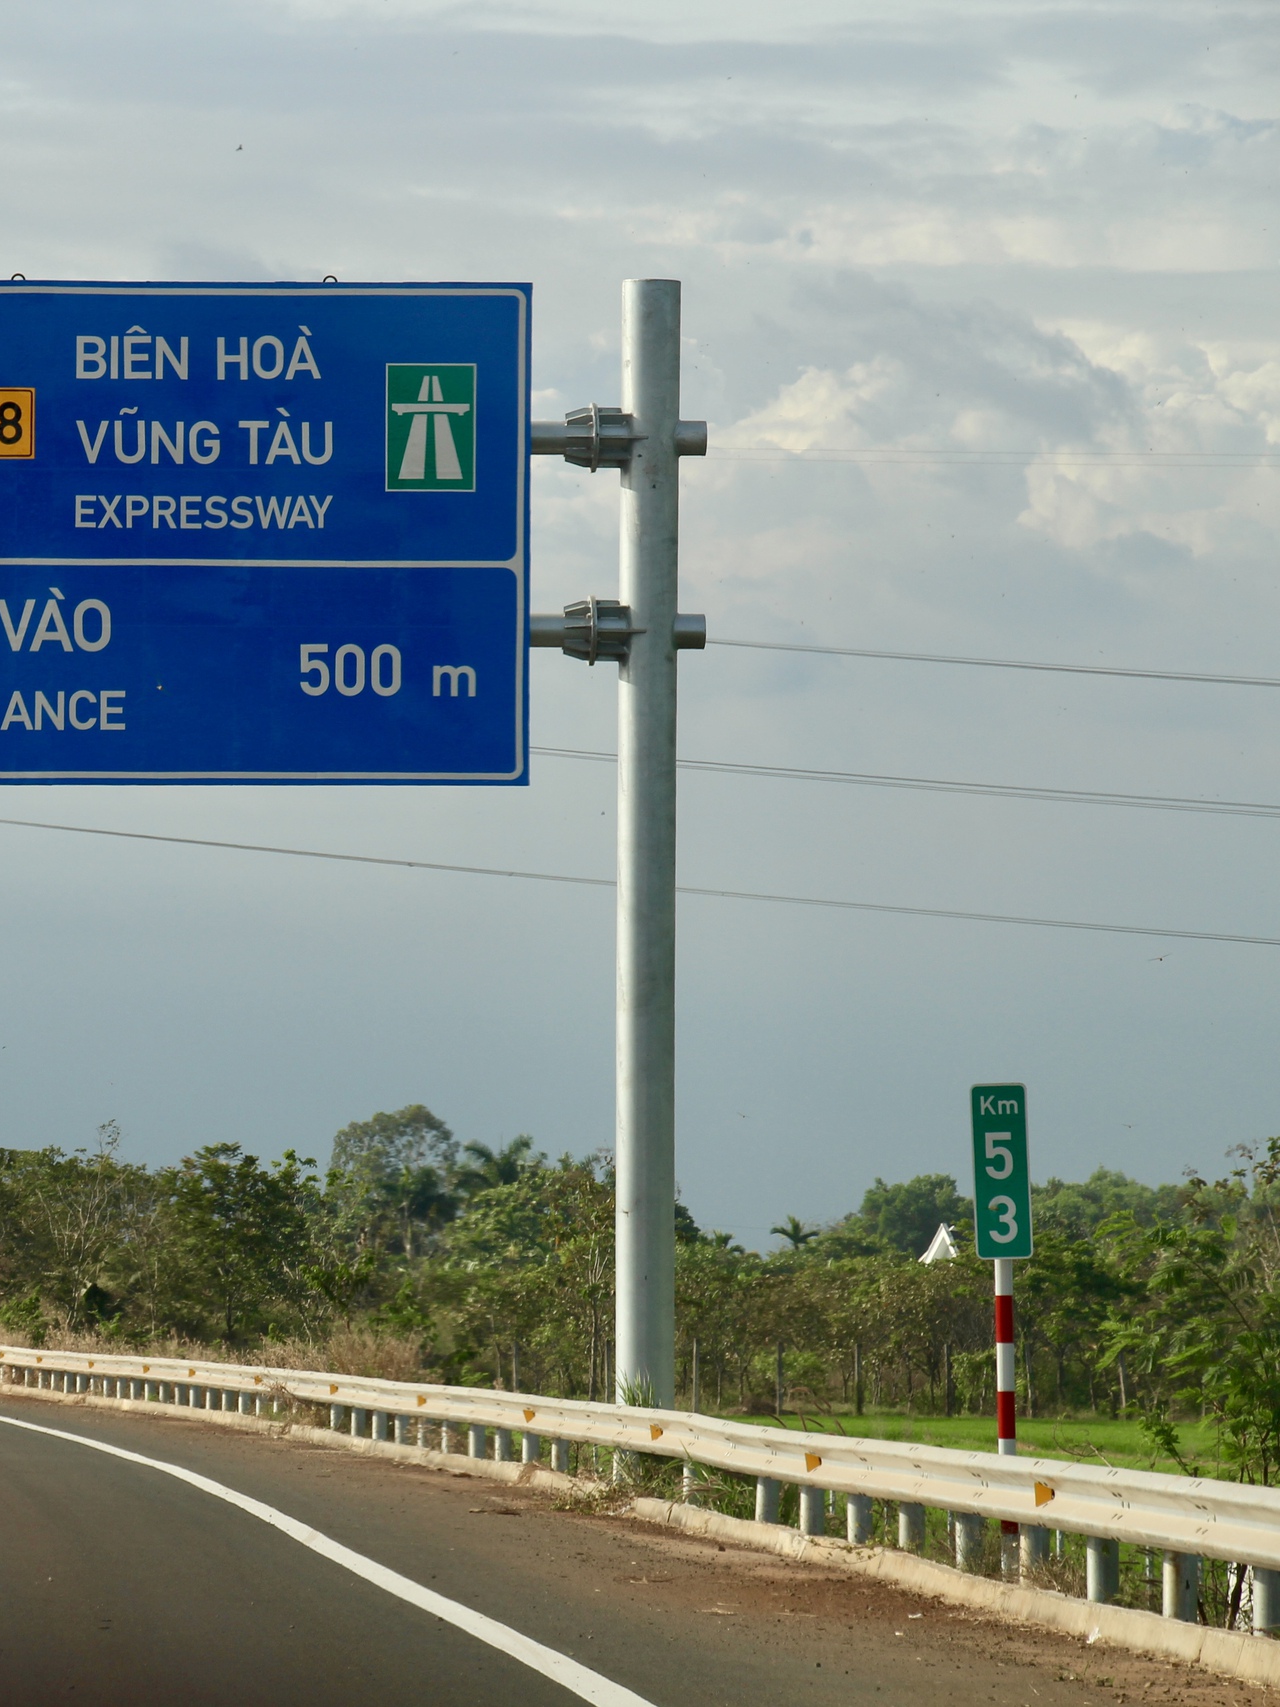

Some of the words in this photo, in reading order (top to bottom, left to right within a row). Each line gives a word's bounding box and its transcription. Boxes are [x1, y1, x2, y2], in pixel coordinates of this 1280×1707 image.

[75, 325, 189, 381] BIÊN
[216, 325, 321, 381] HOÀ
[76, 408, 222, 466] VŨNG
[238, 408, 334, 466] TÀU
[74, 494, 334, 530] EXPRESSWAY
[299, 643, 403, 697] 500
[431, 664, 478, 697] m
[979, 1094, 1019, 1116] Km
